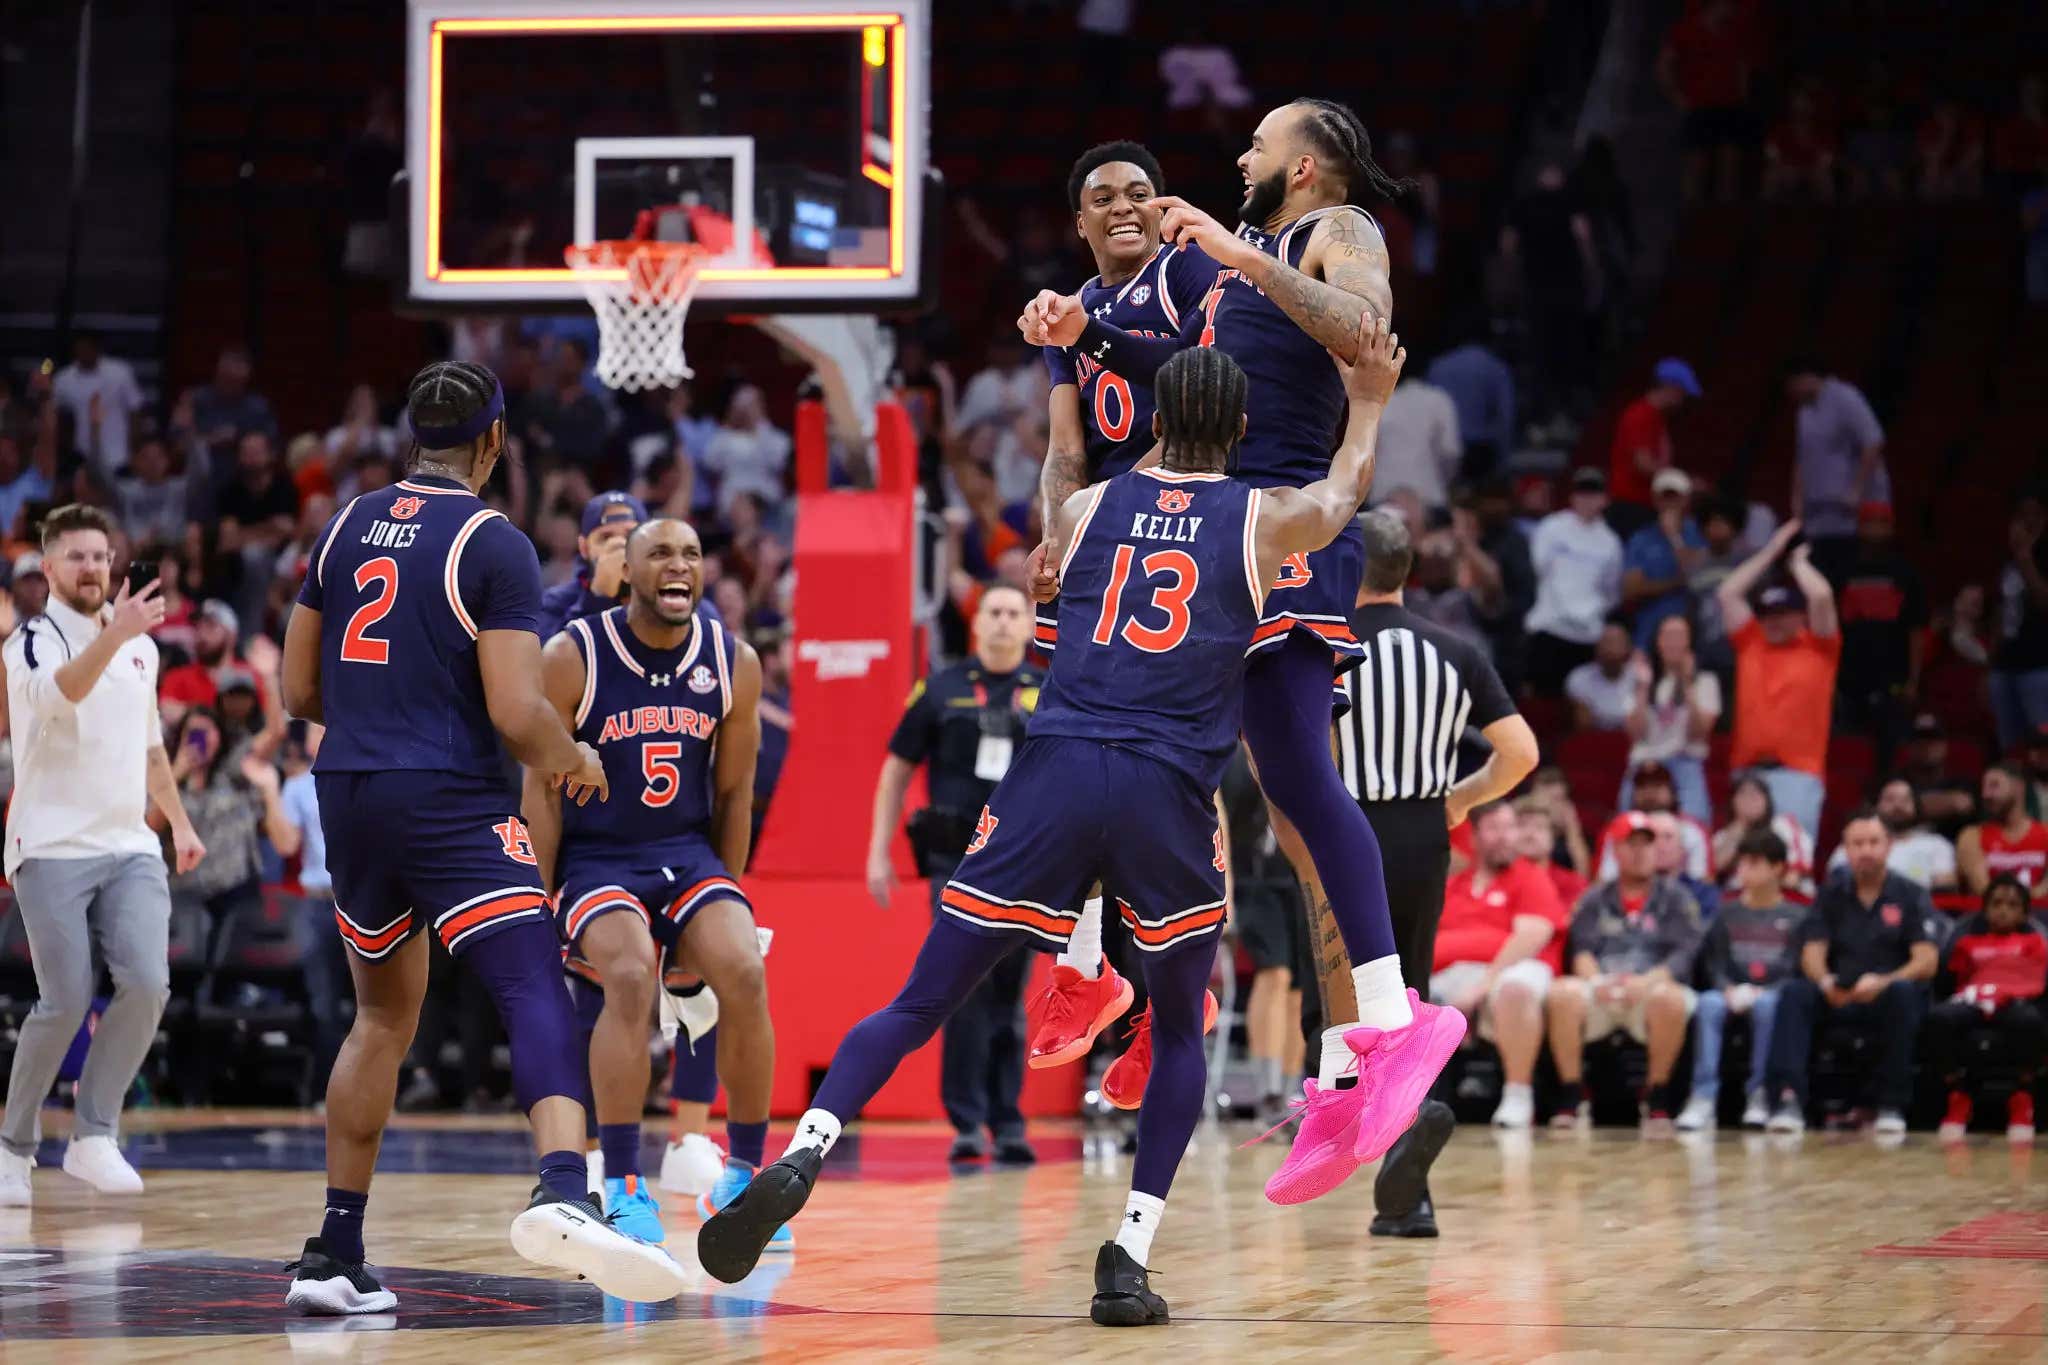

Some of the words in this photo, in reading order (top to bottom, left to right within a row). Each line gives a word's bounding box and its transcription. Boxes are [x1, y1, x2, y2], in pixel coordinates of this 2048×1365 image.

[1095, 370, 1134, 442] 0
[360, 519, 422, 548] JONES
[1130, 512, 1203, 542] KELLY
[340, 556, 399, 665] 2
[1092, 543, 1199, 653] 13
[598, 706, 718, 744] AUBURN
[641, 741, 682, 808] 5
